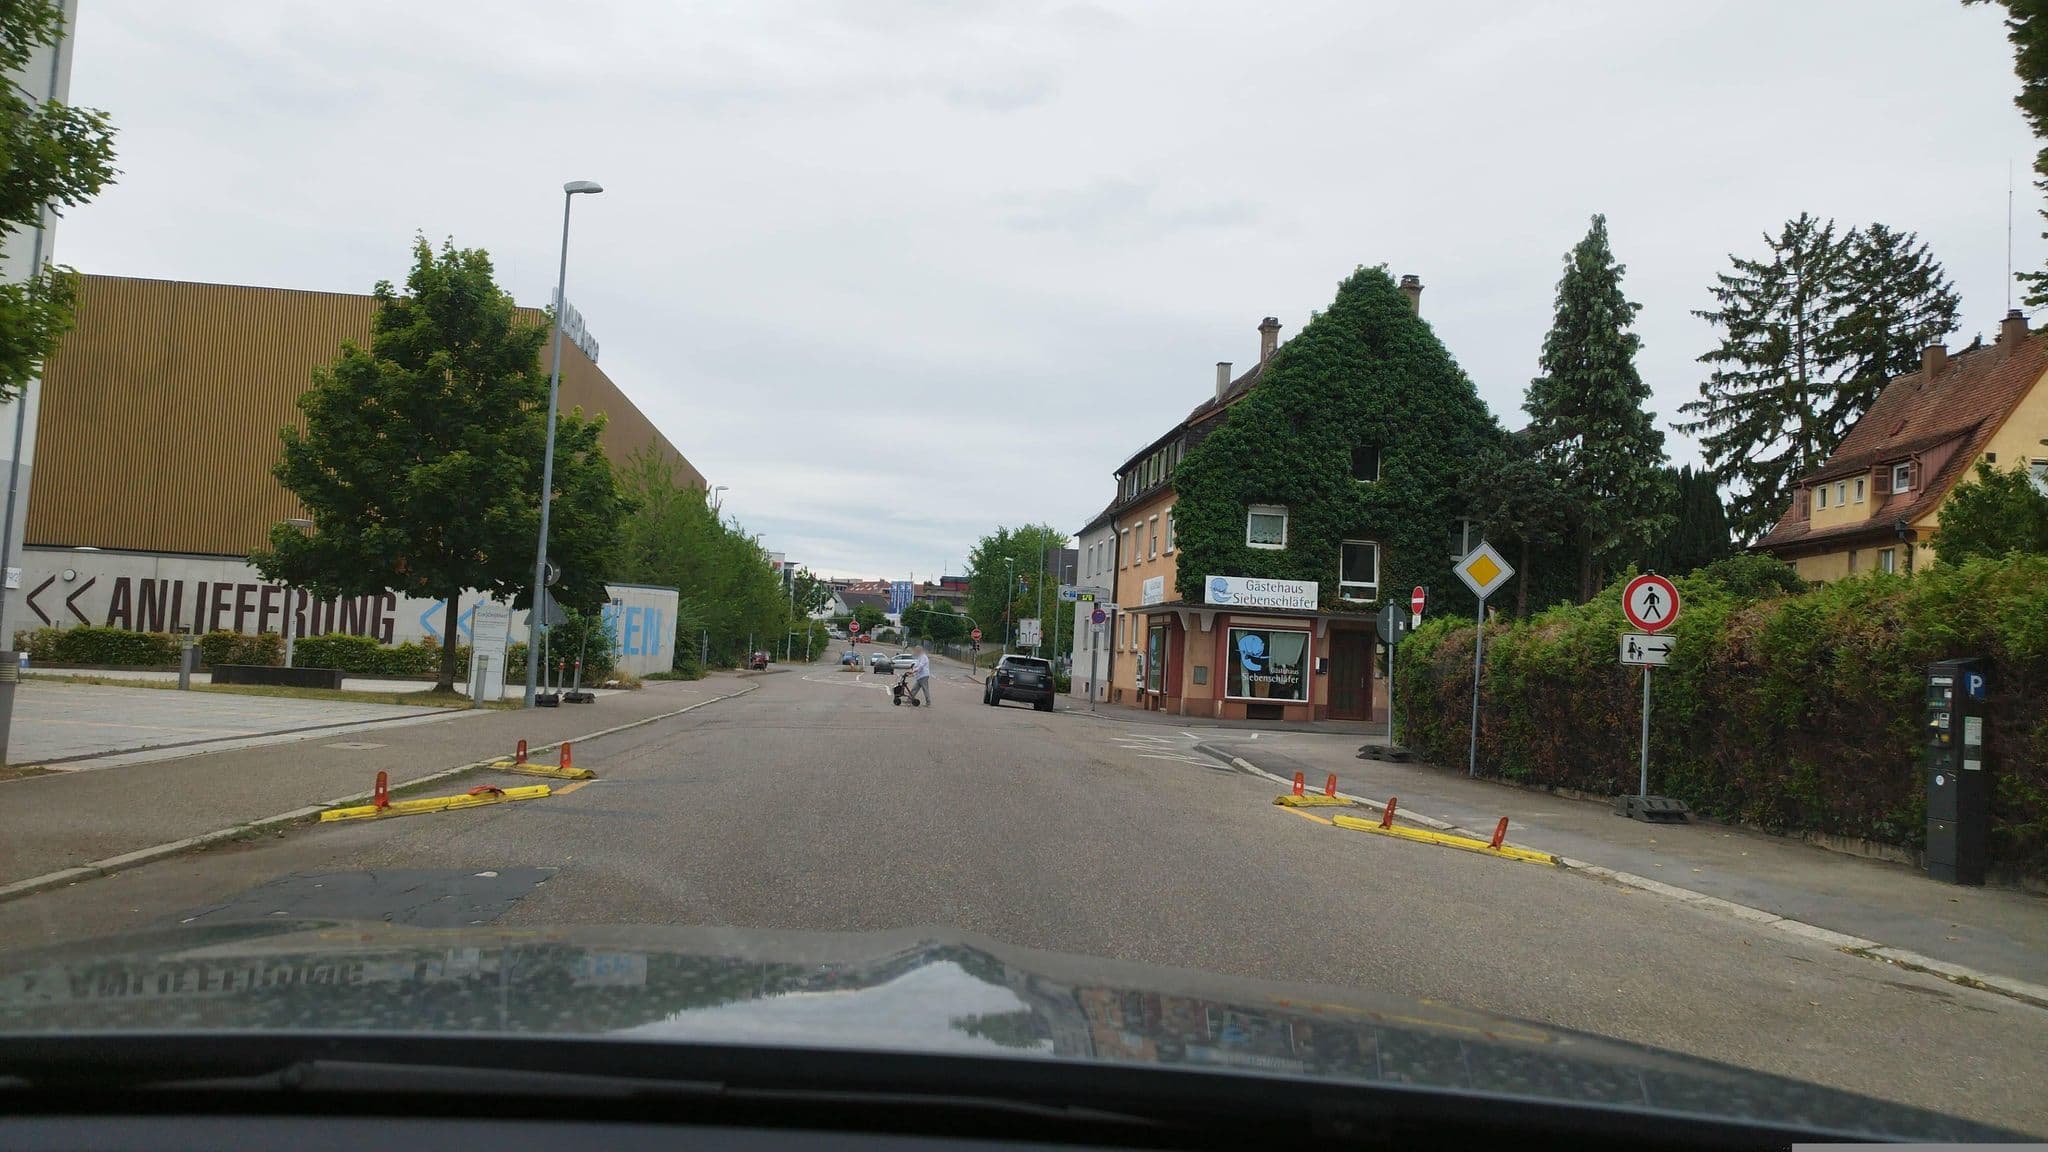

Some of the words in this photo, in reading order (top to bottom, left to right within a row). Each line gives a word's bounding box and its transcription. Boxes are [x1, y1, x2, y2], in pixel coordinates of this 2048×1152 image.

[1245, 579, 1304, 594] Gästehaus
[1232, 592, 1315, 609] Siebenschläfer
[1241, 673, 1299, 684] Siebenschläfer
[1970, 675, 1983, 695] P
